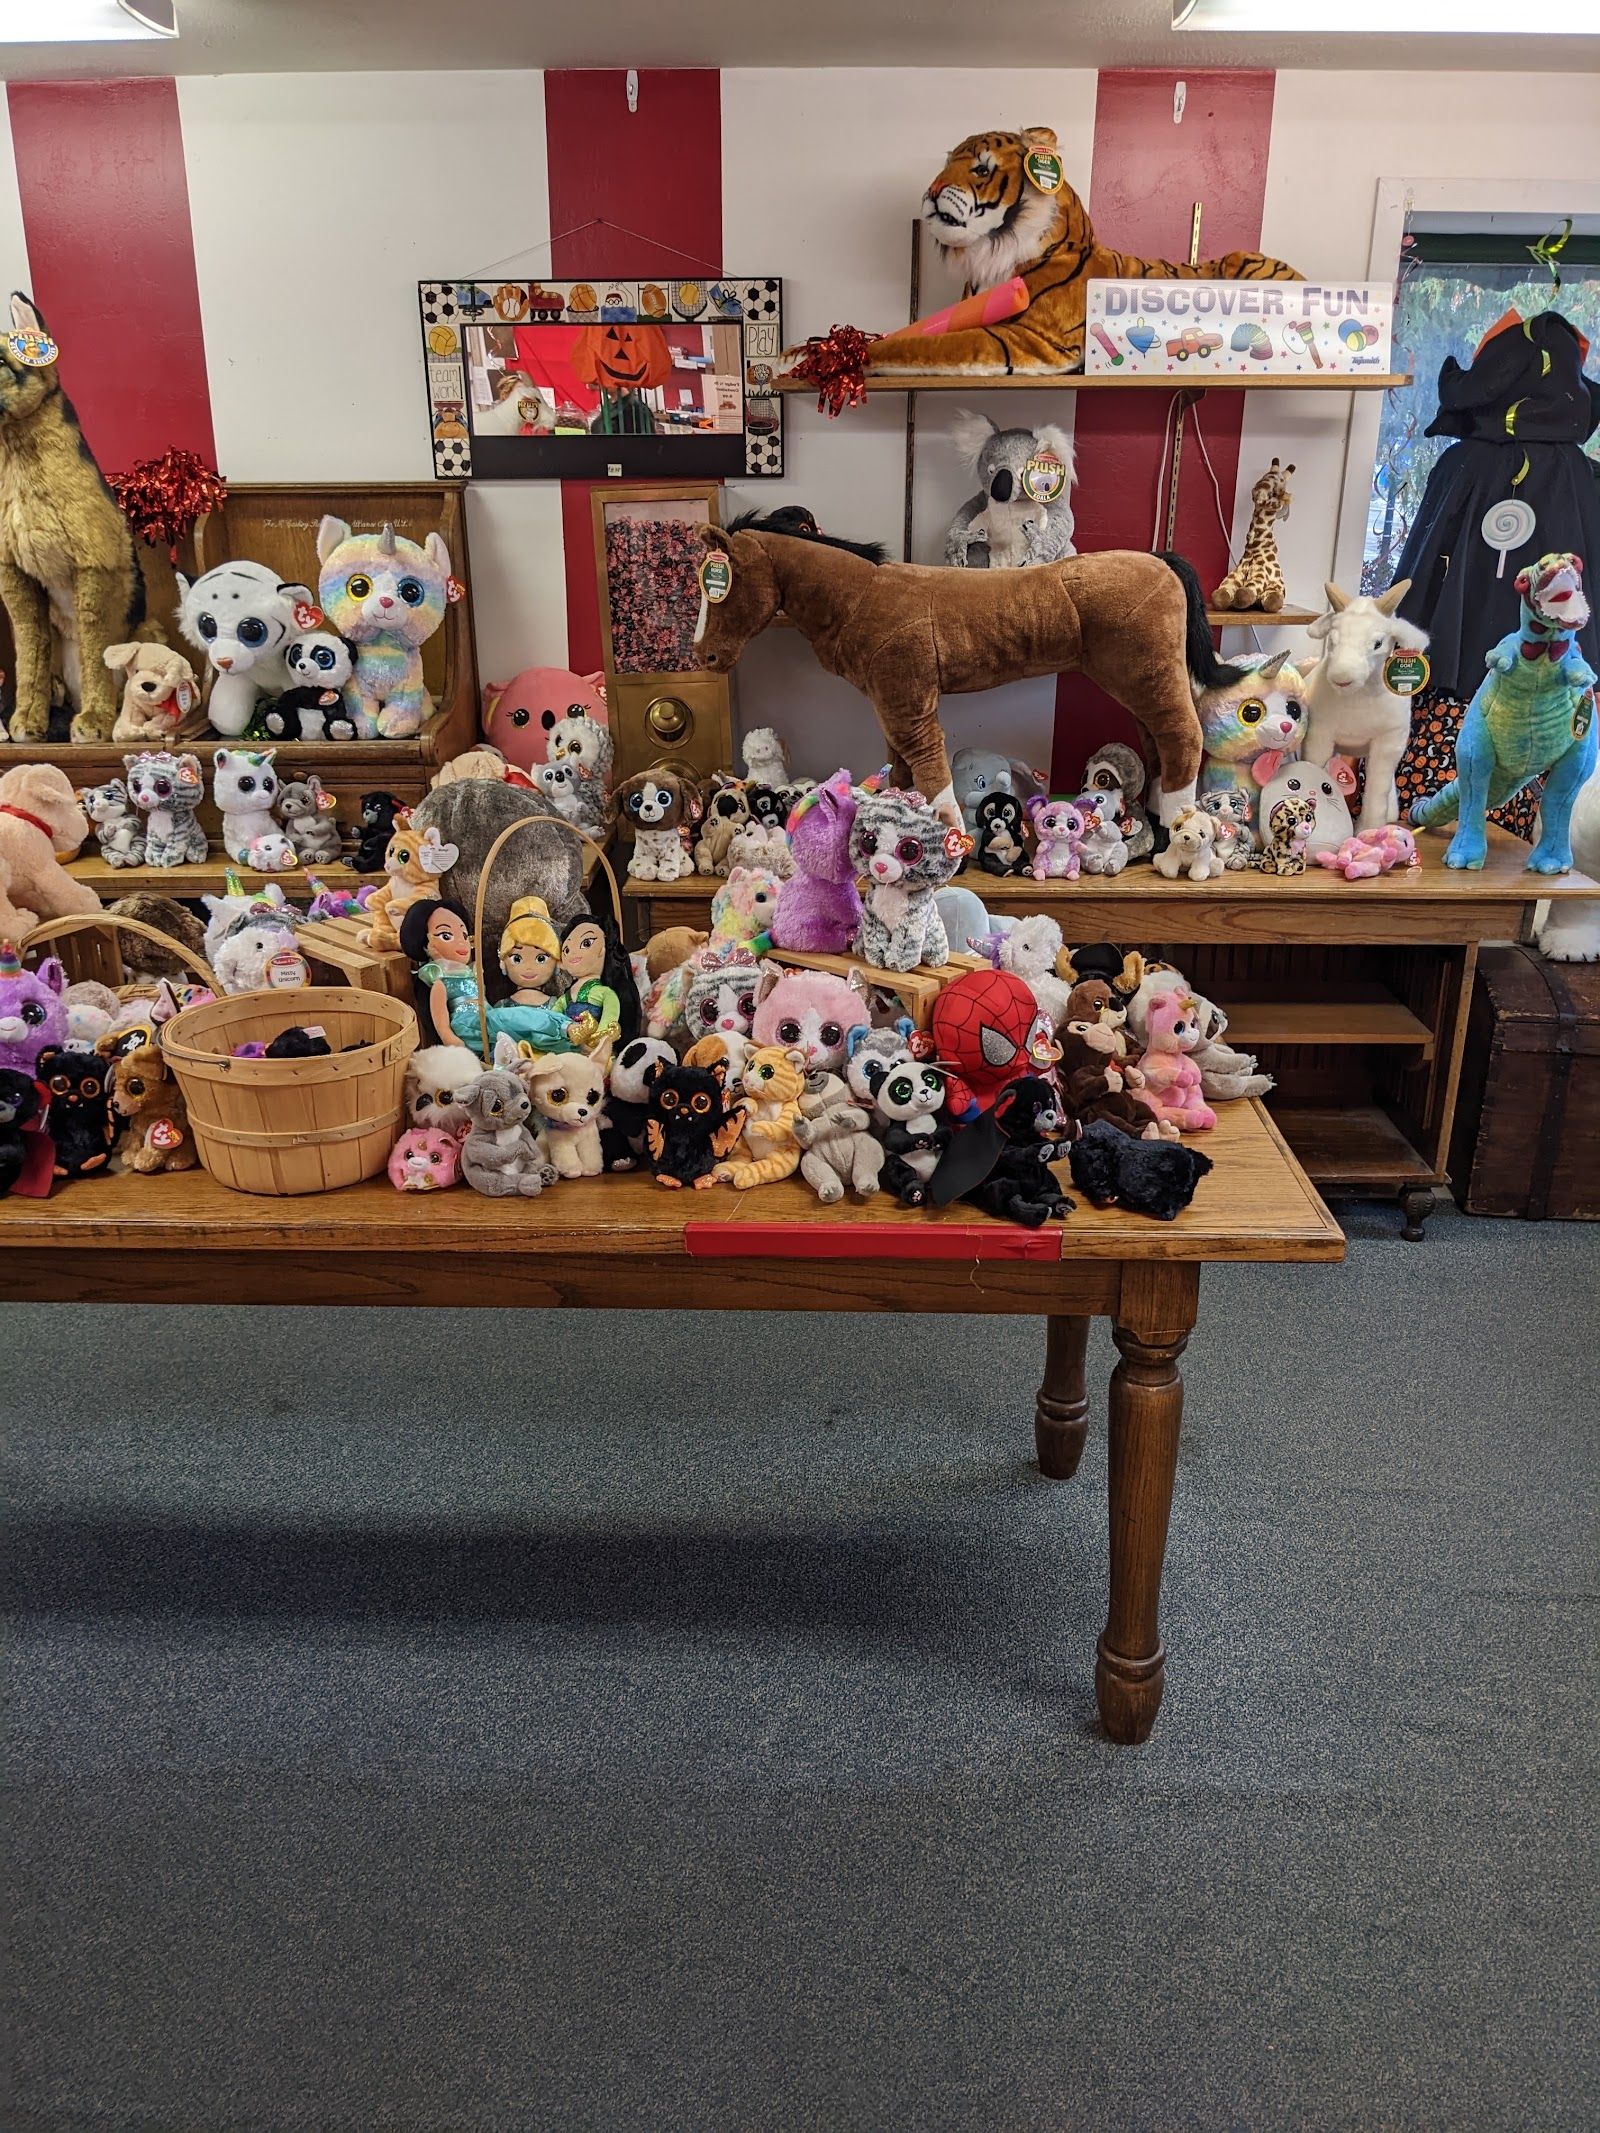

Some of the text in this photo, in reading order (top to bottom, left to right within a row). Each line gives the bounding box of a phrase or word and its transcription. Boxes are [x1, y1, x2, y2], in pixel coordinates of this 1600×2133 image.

[1105, 286, 1369, 317] DISCOVER FUN
[748, 325, 775, 356] Play
[430, 365, 459, 383] team
[1026, 459, 1066, 477] PLUSH
[447, 579, 461, 603] ty
[297, 605, 317, 629] ty
[947, 833, 966, 857] ty
[911, 1035, 929, 1058] ty
[153, 1122, 171, 1146] ty
